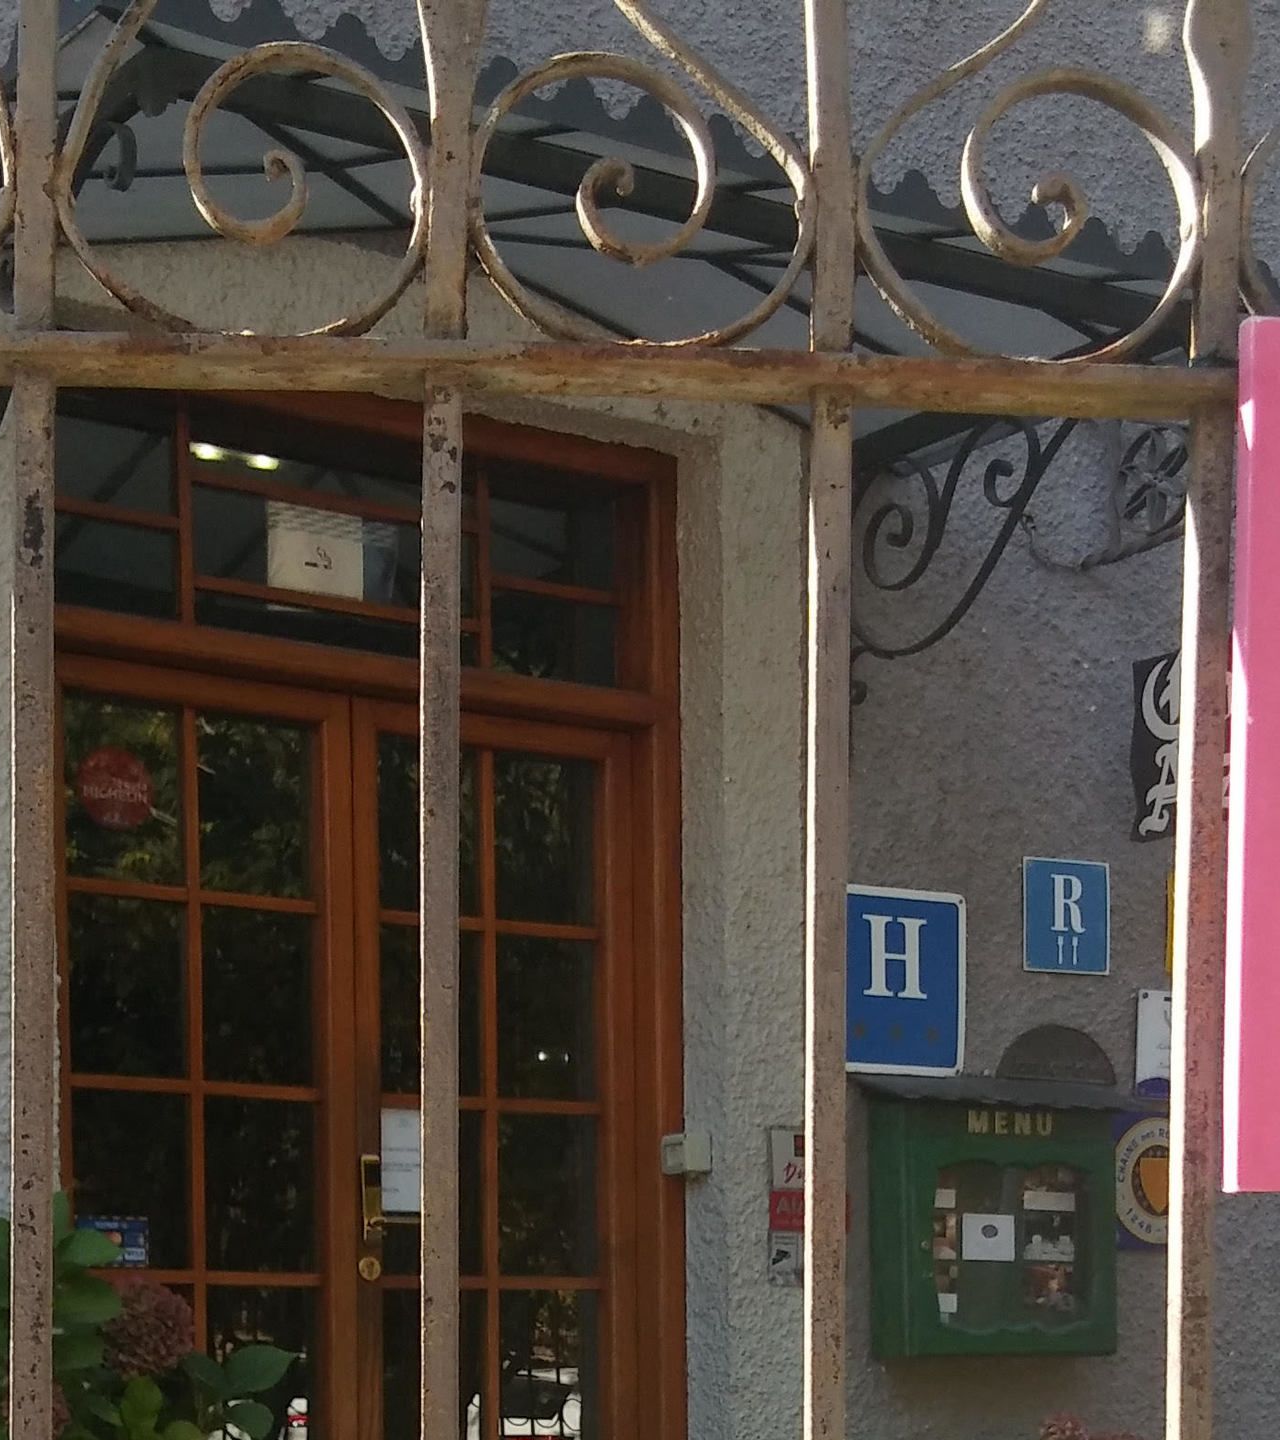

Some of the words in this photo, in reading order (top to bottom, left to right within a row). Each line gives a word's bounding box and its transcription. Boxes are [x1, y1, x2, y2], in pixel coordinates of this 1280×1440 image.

[1050, 873, 1086, 933] R
[862, 913, 928, 999] H
[967, 1110, 1054, 1137] MENU
